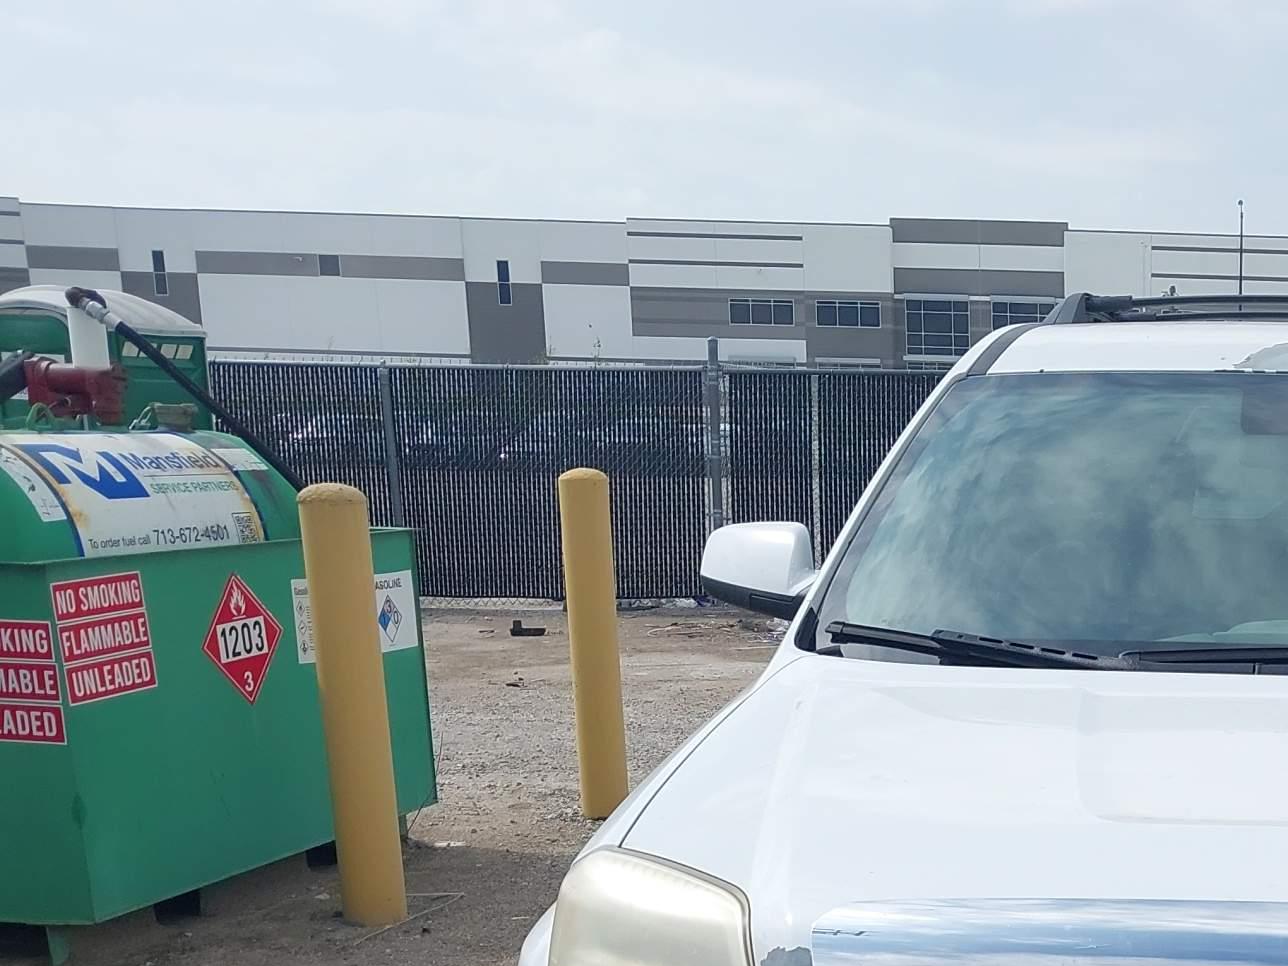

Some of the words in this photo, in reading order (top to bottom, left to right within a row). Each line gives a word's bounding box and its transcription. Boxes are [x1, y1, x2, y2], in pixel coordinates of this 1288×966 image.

[118, 450, 222, 471] Mansfield
[150, 482, 191, 494] SERVICE
[192, 480, 239, 492] PARTNERS
[88, 538, 99, 549] To
[101, 538, 120, 548] order
[122, 537, 136, 547] fuel
[137, 534, 151, 546] call
[152, 524, 230, 545] 713-672-4501
[375, 577, 402, 590] ASOLINE
[56, 589, 76, 615] NO
[79, 579, 141, 611] SMOKING
[384, 599, 392, 614] 3
[61, 618, 149, 657] FLAMMABLE
[221, 620, 265, 660] 1203
[72, 657, 152, 697] UNLEADED
[244, 671, 254, 692] 3
[0, 709, 58, 737] ADED
